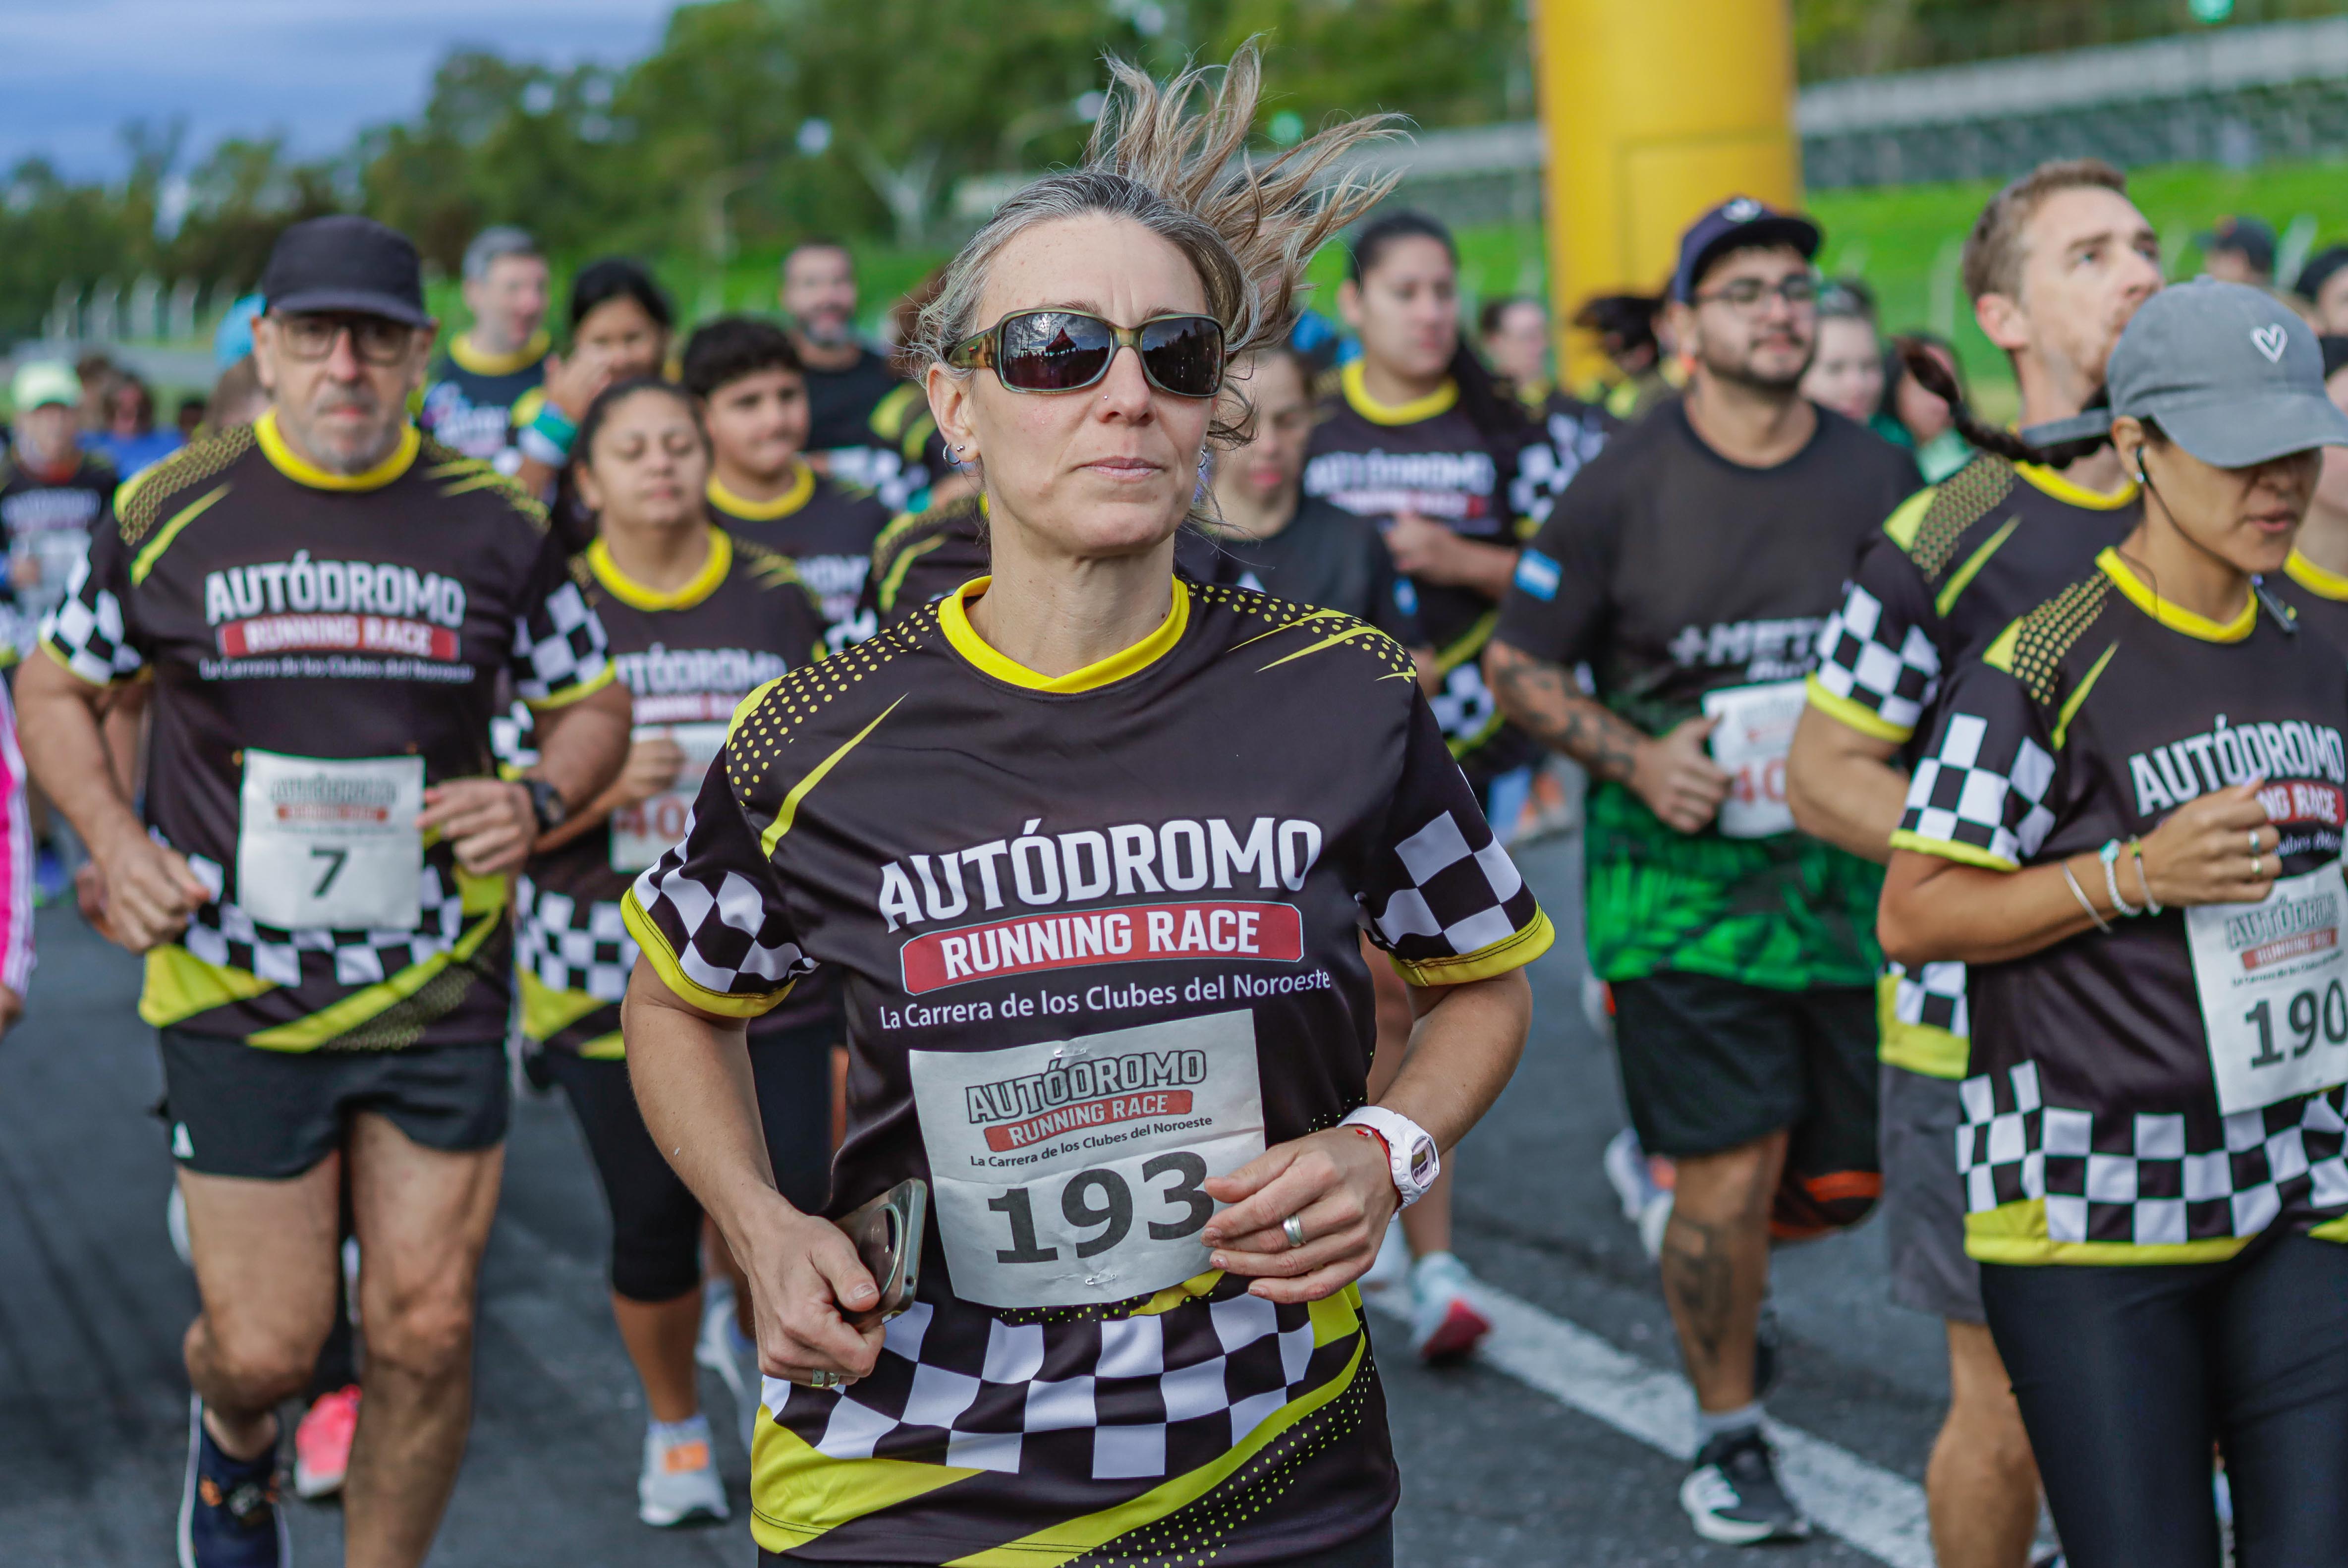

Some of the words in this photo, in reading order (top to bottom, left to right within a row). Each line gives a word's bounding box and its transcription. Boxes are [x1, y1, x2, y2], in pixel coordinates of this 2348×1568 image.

[205, 549, 467, 627] AUTÓDROMO
[242, 614, 360, 653] RUNNING
[362, 616, 434, 658] RACE
[2128, 713, 2346, 817] AUTÓDROMO
[311, 847, 348, 898] 7
[879, 817, 1322, 933] AUTÓDROMO
[940, 913, 1132, 980] RUNNING
[1146, 909, 1261, 953] RACE
[880, 1006, 901, 1029] La
[905, 1000, 994, 1027] Carrera
[1001, 993, 1034, 1018] de
[1041, 990, 1079, 1014] los
[1086, 983, 1177, 1010] Clubes
[1185, 974, 1225, 1002] del
[1234, 969, 1331, 998] Noroeste
[2244, 978, 2348, 1069] 190
[965, 1050, 1206, 1124] AUTÓDROMO
[1007, 1103, 1106, 1146] RUNNING
[1112, 1094, 1168, 1120] RACE
[970, 1155, 986, 1167] La
[988, 1154, 1039, 1167] Carrera
[1041, 1146, 1058, 1160] de
[1060, 1141, 1080, 1155] los
[1082, 1133, 1128, 1149] Clubes
[1130, 1123, 1151, 1139] del
[1153, 1116, 1213, 1133] Noroeste
[987, 1151, 1215, 1264] 193
